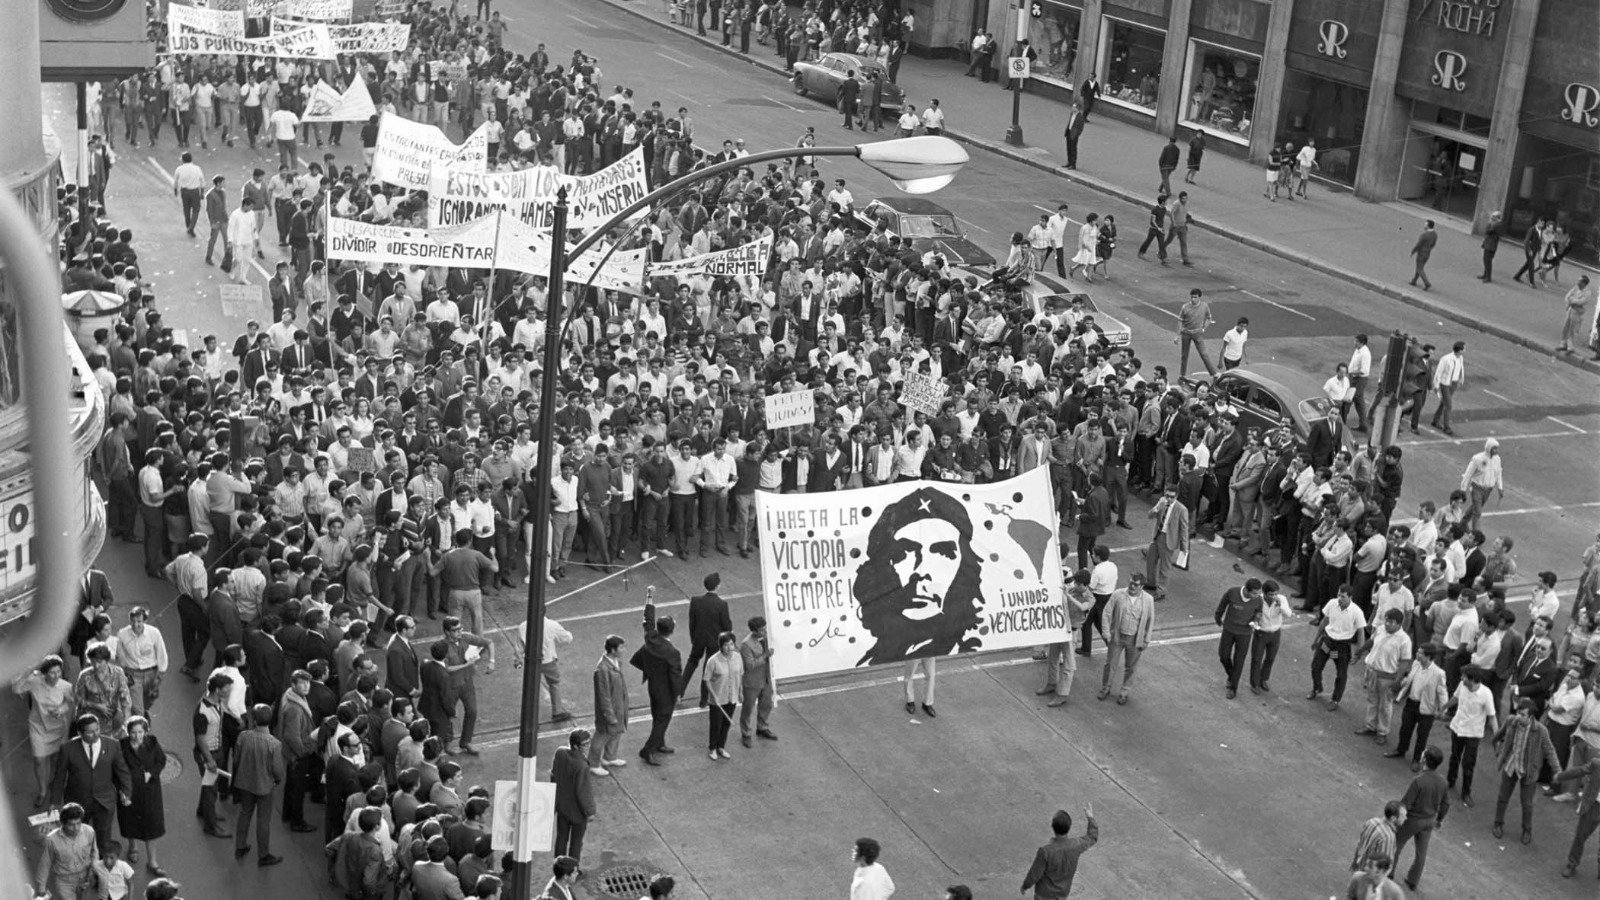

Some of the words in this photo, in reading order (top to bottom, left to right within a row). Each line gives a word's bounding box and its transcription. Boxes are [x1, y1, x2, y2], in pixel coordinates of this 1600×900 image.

[1437, 1, 1495, 36] ROCHA
[172, 36, 199, 51] LOS
[446, 170, 490, 198] ESTOS
[501, 174, 527, 199] SON
[535, 169, 560, 197] LOS
[520, 201, 554, 228] HAMB
[596, 181, 645, 218] MISERIA
[332, 236, 377, 254] DIVIDIR
[705, 261, 764, 275] NORMAL
[839, 506, 859, 527] LA
[772, 537, 846, 570] VICTORIA
[989, 605, 1065, 634] VENCEREMOS
